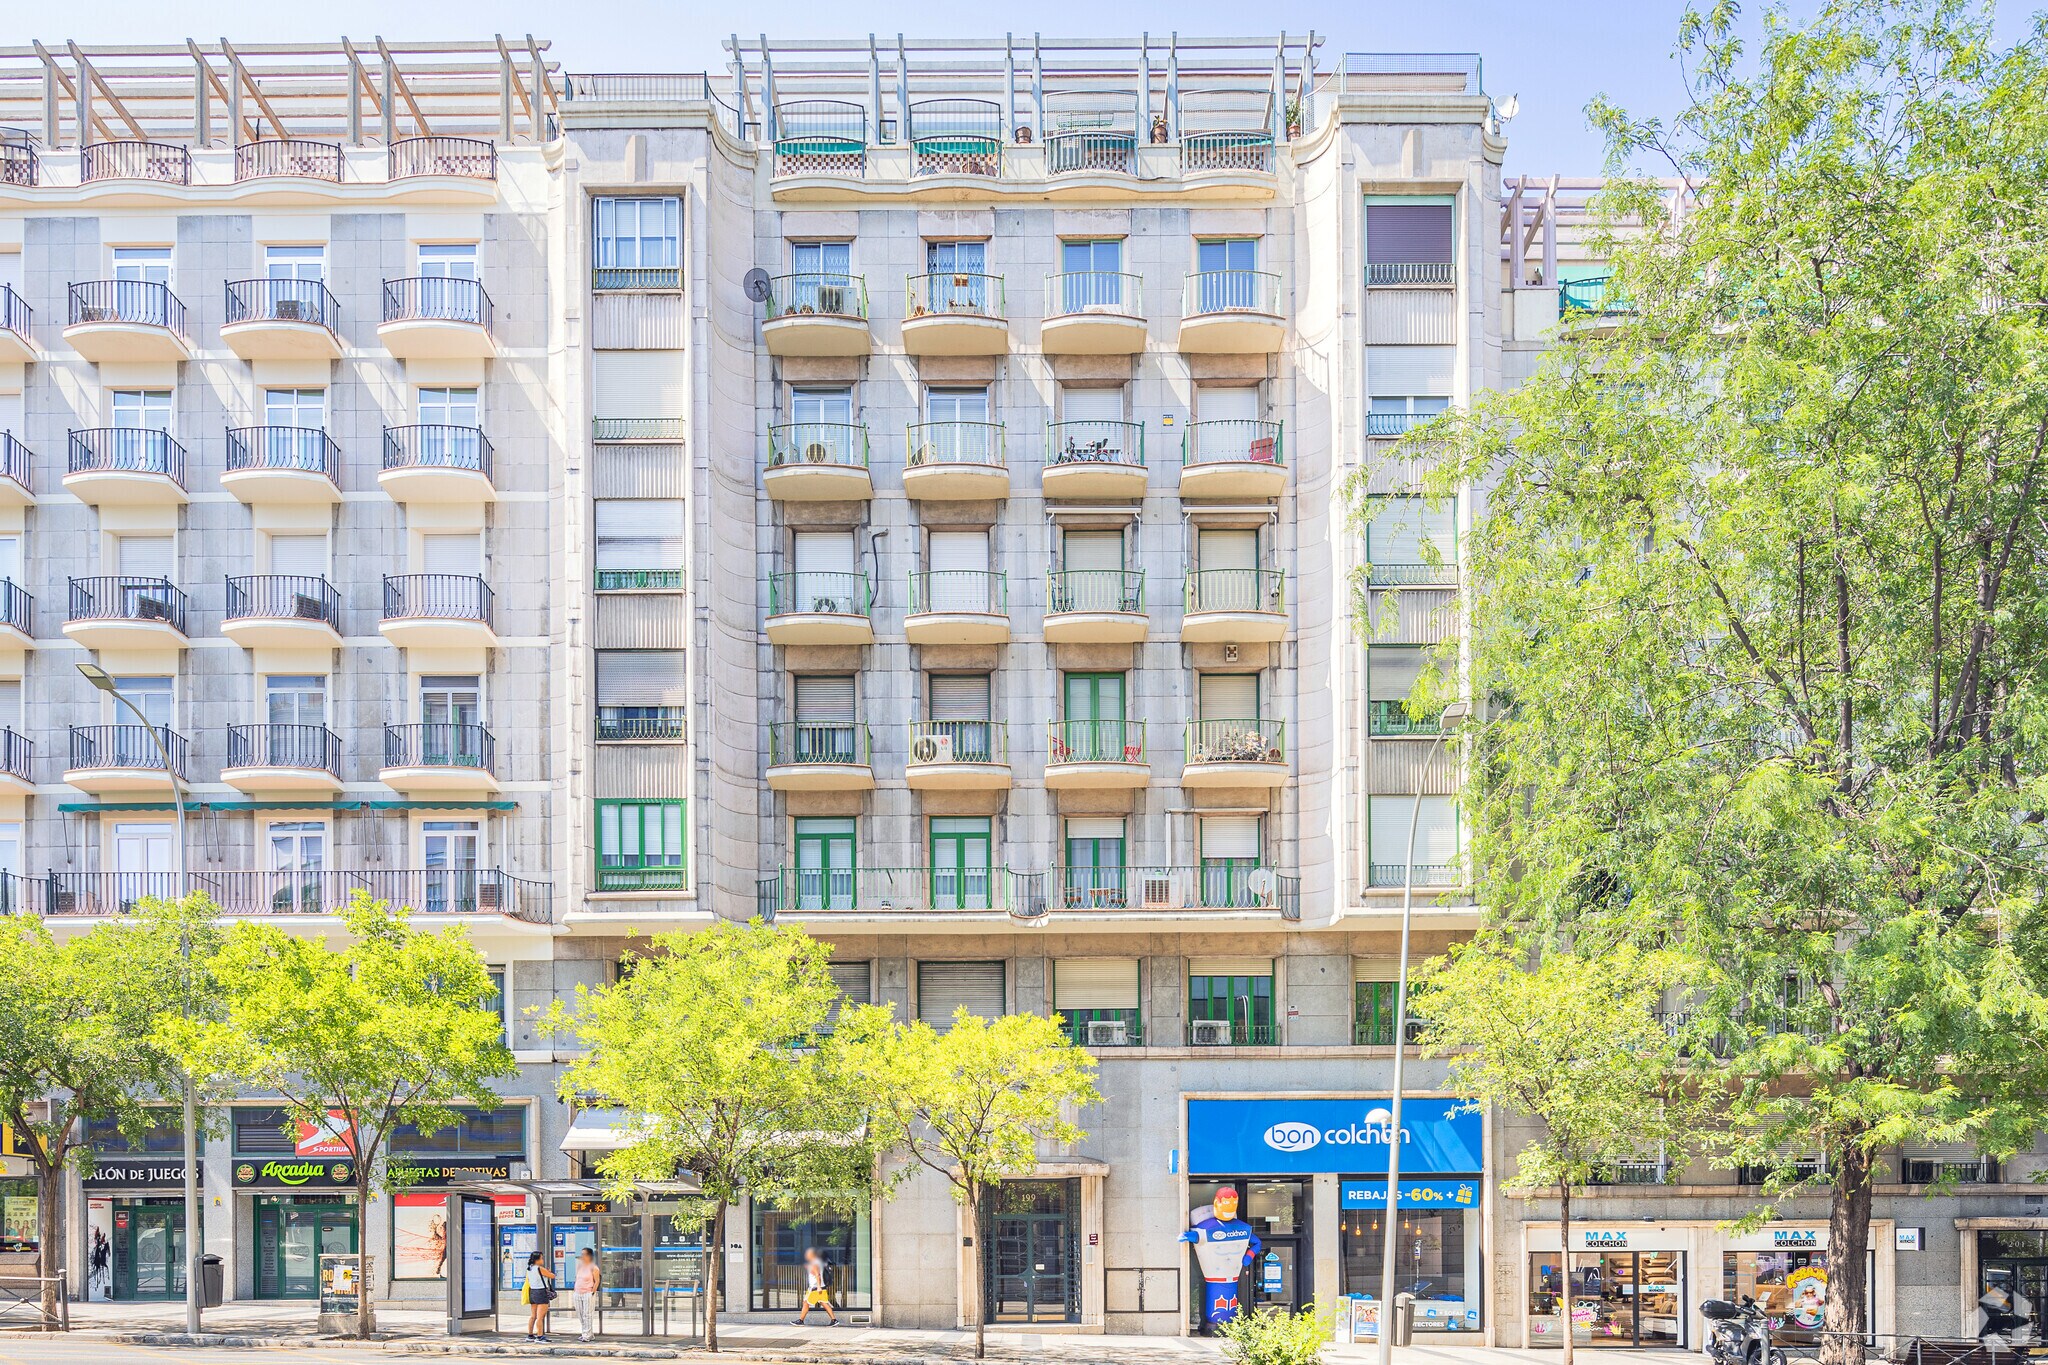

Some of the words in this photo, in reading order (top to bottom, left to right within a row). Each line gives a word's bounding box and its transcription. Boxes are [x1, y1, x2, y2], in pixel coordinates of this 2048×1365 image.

[1271, 1126, 1315, 1145] bon
[82, 1166, 126, 1181] ALÓN
[130, 1169, 145, 1180] DE
[442, 1167, 507, 1177] DETIVAS
[1021, 1193, 1037, 1202] 199
[1348, 1190, 1403, 1200] REBAJS
[1404, 1187, 1444, 1202] -60%
[1585, 1231, 1627, 1240] MAX
[1774, 1231, 1816, 1240] MAX
[1585, 1240, 1628, 1248] COLCHON
